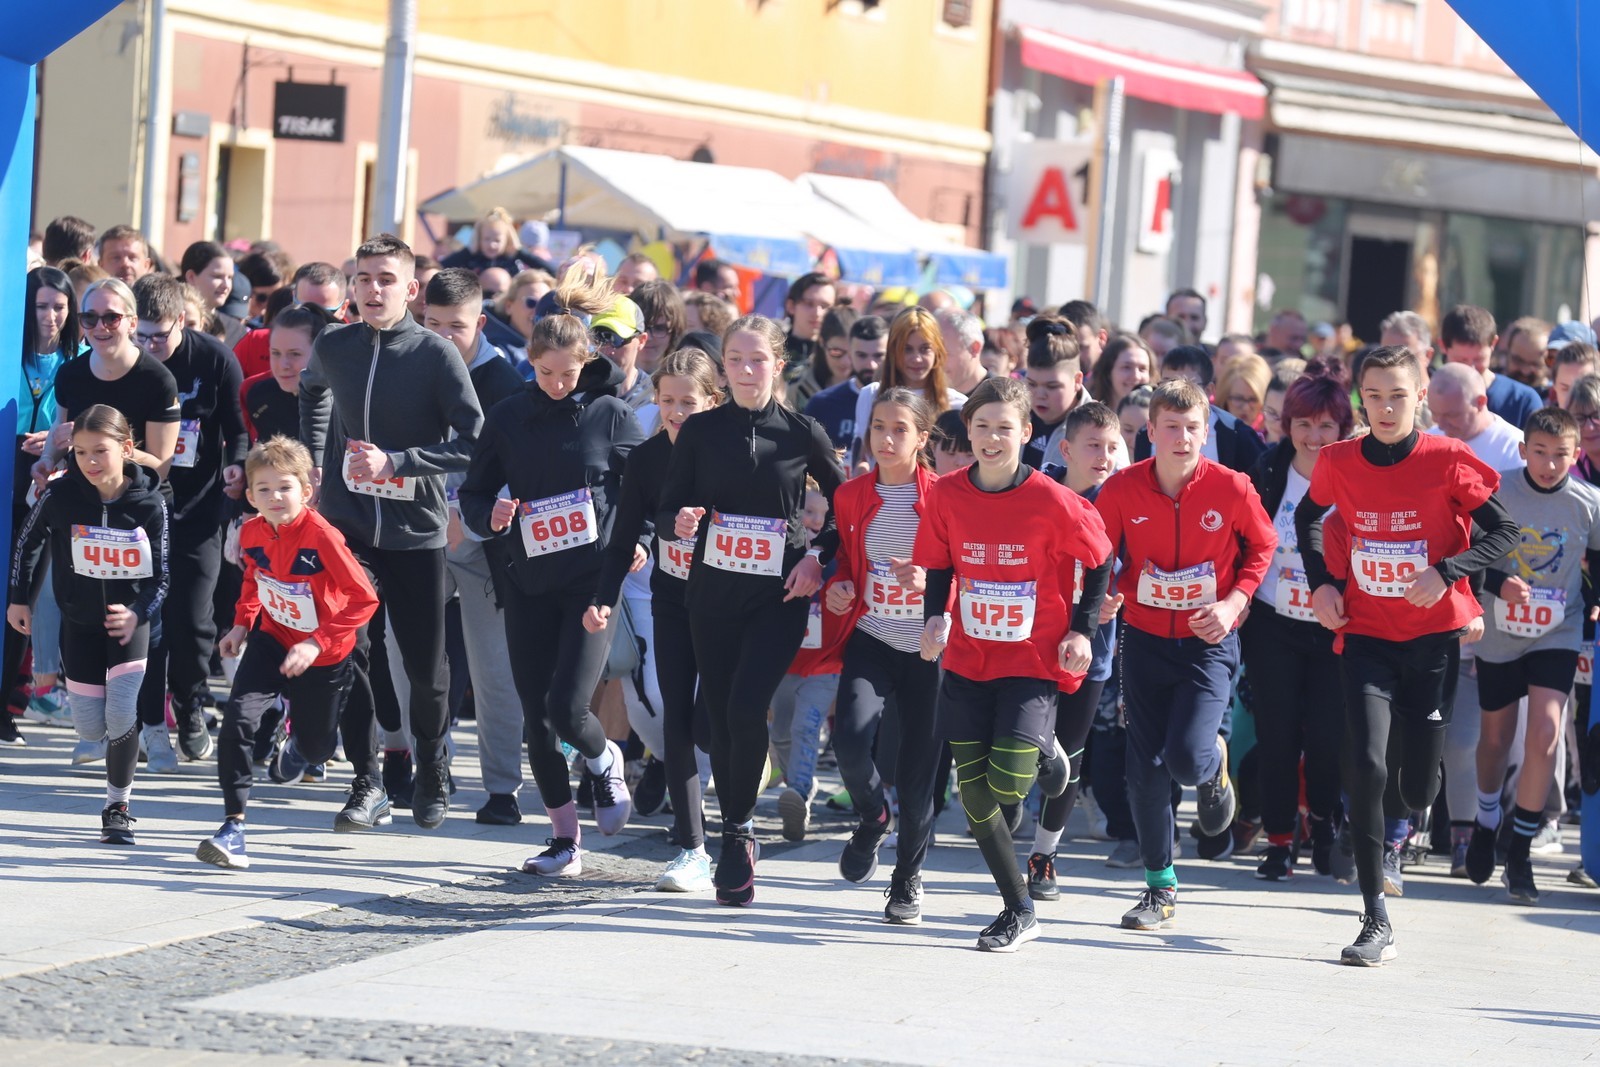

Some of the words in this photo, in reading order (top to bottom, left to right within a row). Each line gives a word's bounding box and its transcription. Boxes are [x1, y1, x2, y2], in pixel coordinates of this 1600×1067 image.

[278, 115, 336, 137] TISAK
[532, 511, 587, 541] 608
[84, 546, 140, 567] 440
[716, 534, 771, 560] 483
[267, 588, 301, 619] 173
[873, 582, 922, 605] 522
[1151, 583, 1202, 600] 192
[972, 602, 1023, 627] 475
[1505, 602, 1552, 626] 110
